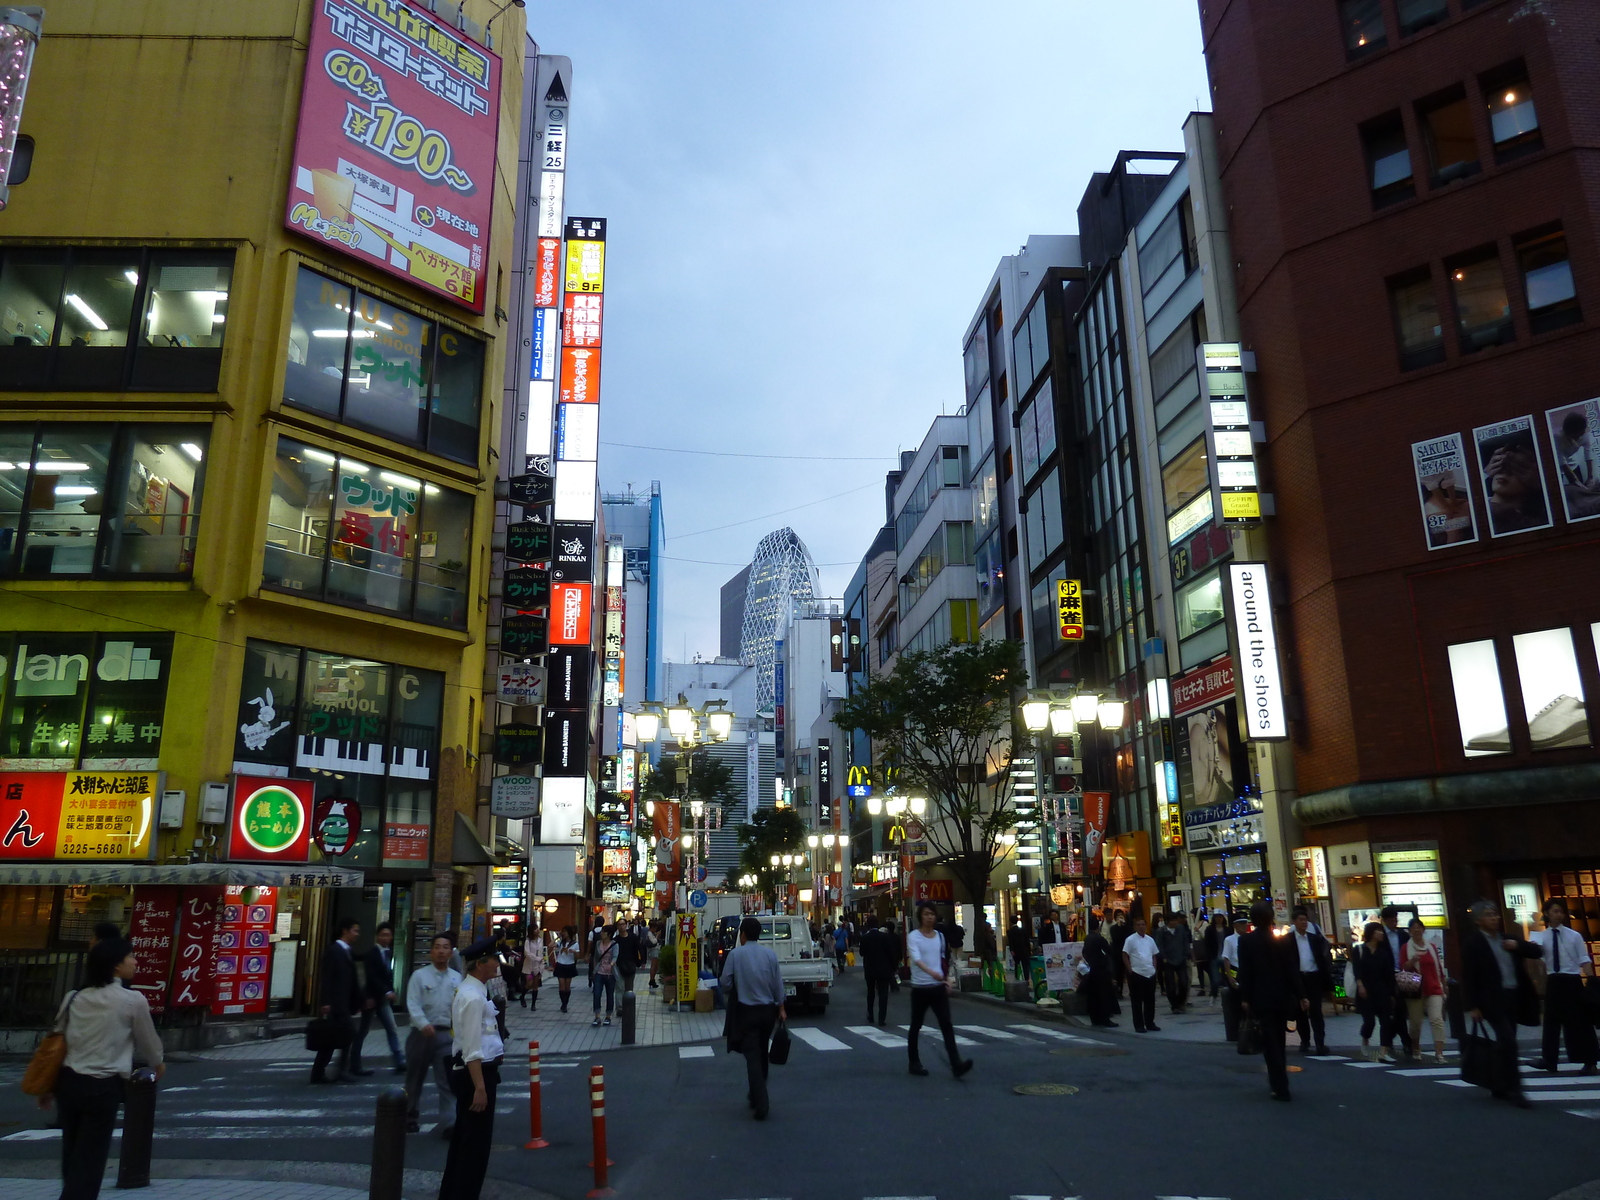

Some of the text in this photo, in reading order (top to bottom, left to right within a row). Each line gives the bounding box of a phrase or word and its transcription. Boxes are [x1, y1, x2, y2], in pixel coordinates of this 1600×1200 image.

[352, 0, 484, 81] んが喫茶
[328, 6, 485, 113] インターネット
[330, 56, 379, 95] 60分
[547, 125, 563, 152] 三経
[545, 157, 561, 167] 25
[346, 167, 391, 196] 大塚家具
[531, 198, 538, 207] 8
[435, 206, 479, 238] 現在地
[471, 243, 482, 271] 新宿駅
[415, 249, 472, 286] ペガサス館
[445, 278, 472, 298] 6F
[582, 283, 600, 291] 9F
[320, 281, 459, 357] MUSIC
[363, 326, 422, 359] SCHOOL
[523, 338, 530, 347] 6
[534, 310, 543, 378] ビー・エスコート
[355, 345, 425, 388] ウッド
[519, 412, 526, 421] 5
[1417, 438, 1458, 459] SAKURA
[1420, 456, 1461, 478] 整体院
[341, 475, 417, 518] ウッド
[1428, 514, 1447, 528] 3F
[341, 510, 409, 557] 受付
[510, 535, 548, 549] ウッド
[1175, 550, 1187, 579] 3F
[507, 582, 547, 597] ウッド
[1062, 583, 1077, 595] 3F
[1060, 596, 1082, 625] 麻雀
[504, 630, 543, 643] ウッド
[1241, 571, 1271, 730] around the shoes
[264, 651, 420, 700] MUSIC
[501, 675, 542, 687] ラーメン
[512, 667, 531, 676] 熊本
[1173, 678, 1205, 705] 質セキネ
[312, 695, 380, 714] SCHOOL
[34, 722, 162, 744] 生徒募集中
[310, 710, 379, 739] ウッド
[502, 777, 531, 785] WOOD
[820, 760, 829, 783] メガネ
[0, 783, 24, 800] 店
[69, 799, 138, 810] 大小宴会受付中
[256, 800, 293, 819] 熊本
[66, 823, 123, 831] 味と地酒の店
[67, 814, 133, 824] 花籠部屋直伝の
[249, 820, 294, 835] らーめん
[1171, 814, 1181, 835] 麻雀
[409, 828, 428, 837] ウッド
[63, 844, 123, 855] 3225-5680
[289, 873, 344, 887] 新宿本店
[693, 894, 701, 905] P
[131, 935, 170, 949] 新宿本店
[177, 897, 211, 1003] ひごのれん
